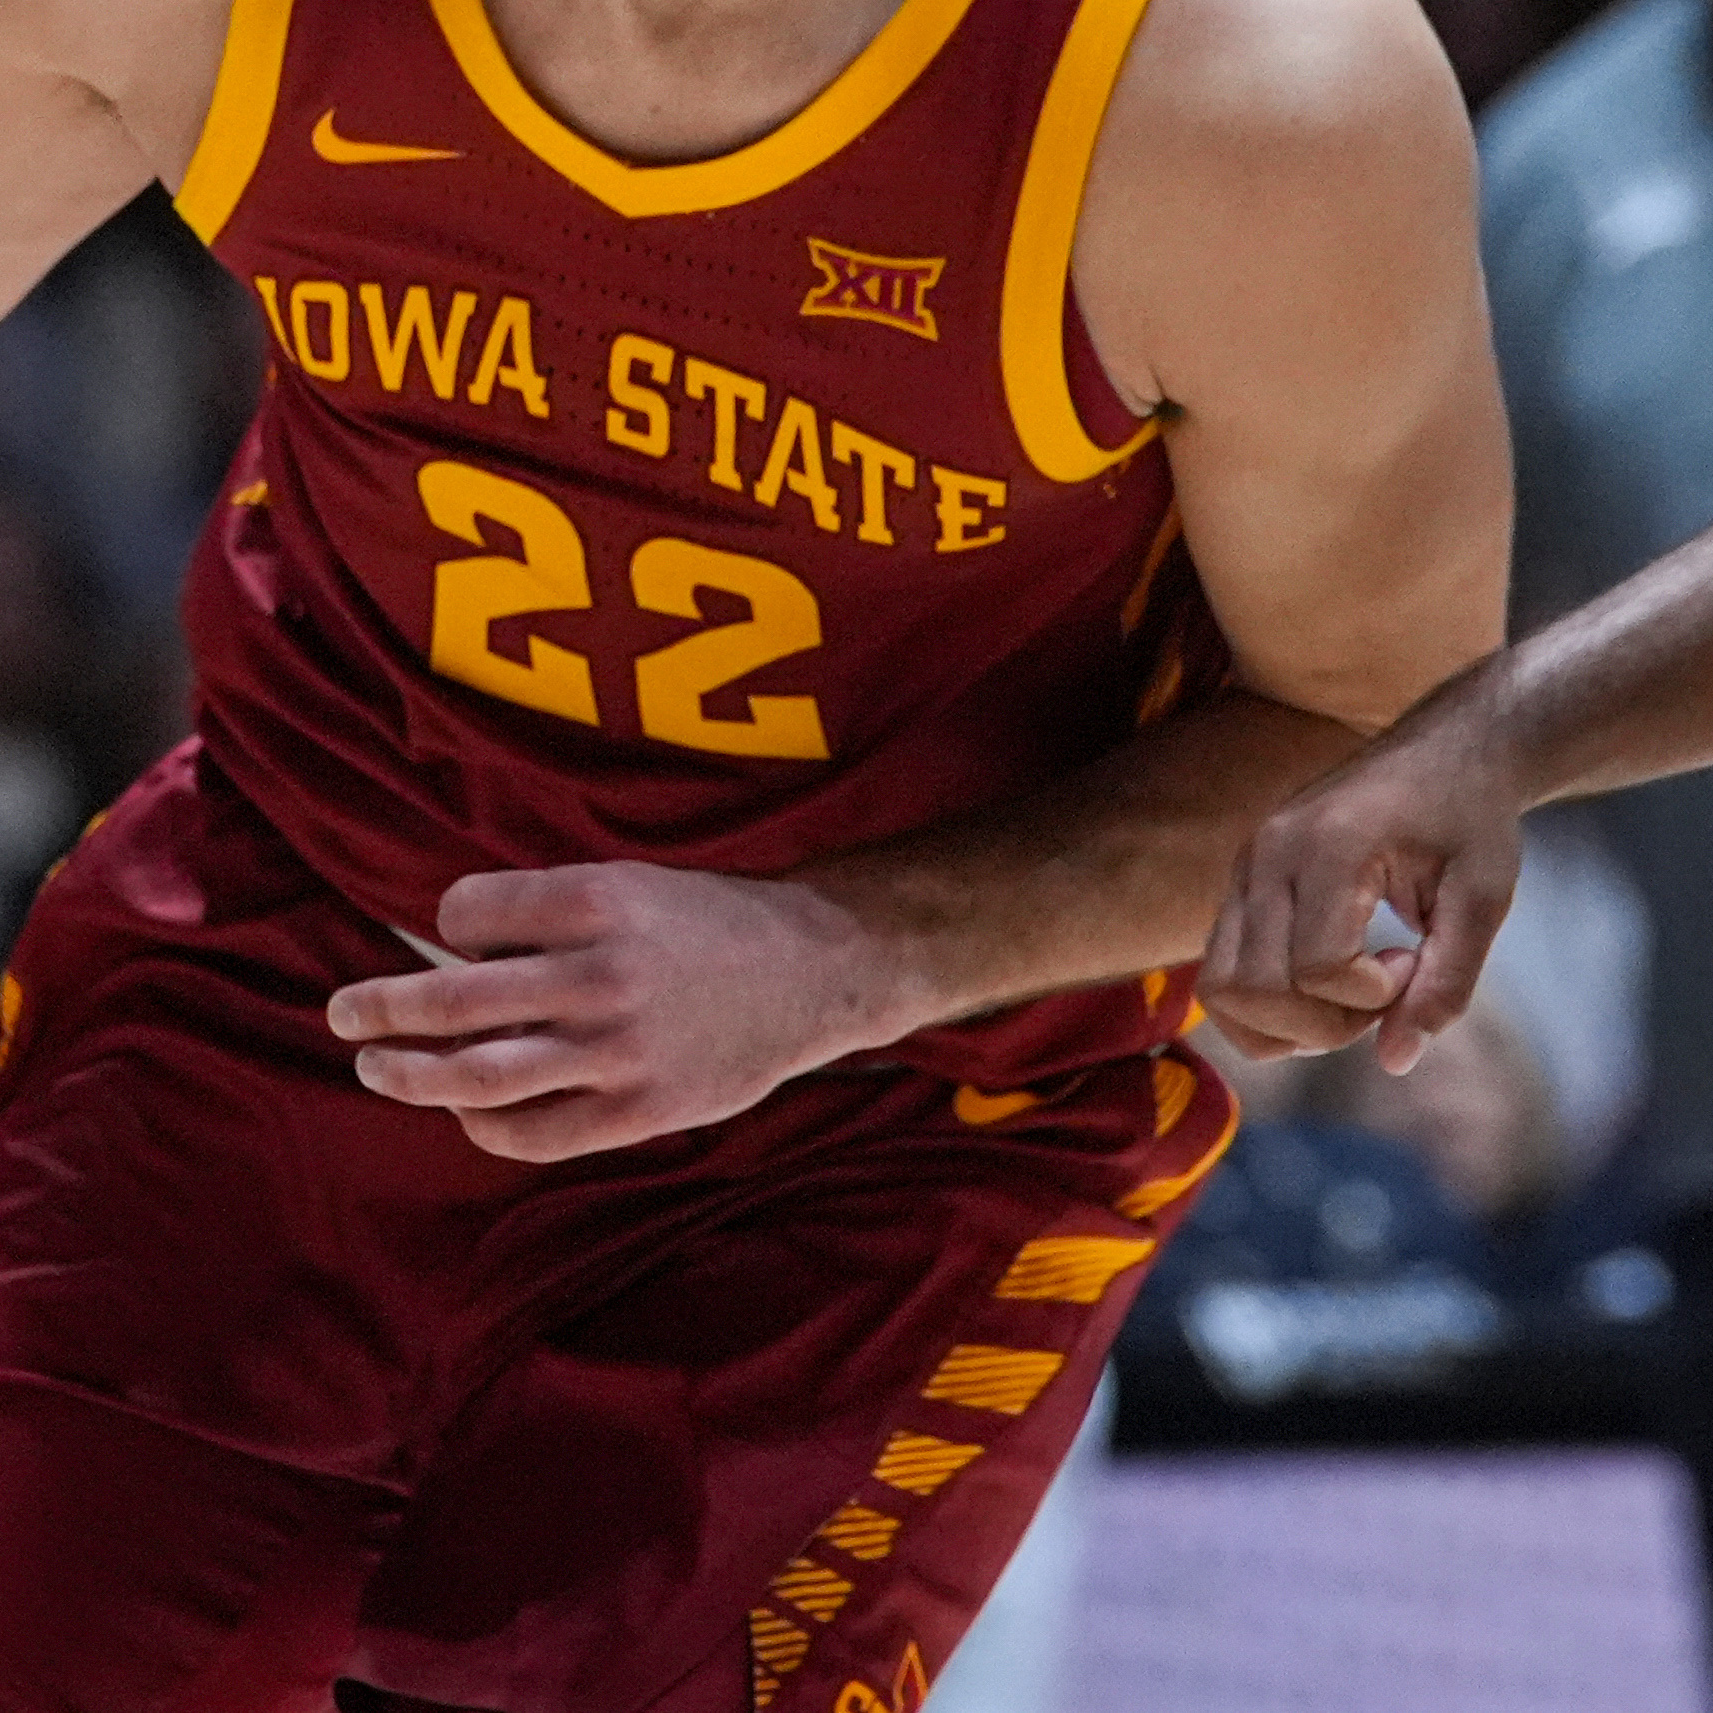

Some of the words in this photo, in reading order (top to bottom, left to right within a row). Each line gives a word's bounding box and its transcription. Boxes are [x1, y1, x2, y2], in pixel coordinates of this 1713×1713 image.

[799, 236, 947, 342] XII
[606, 332, 1007, 554] STATE
[416, 460, 830, 760] 22
